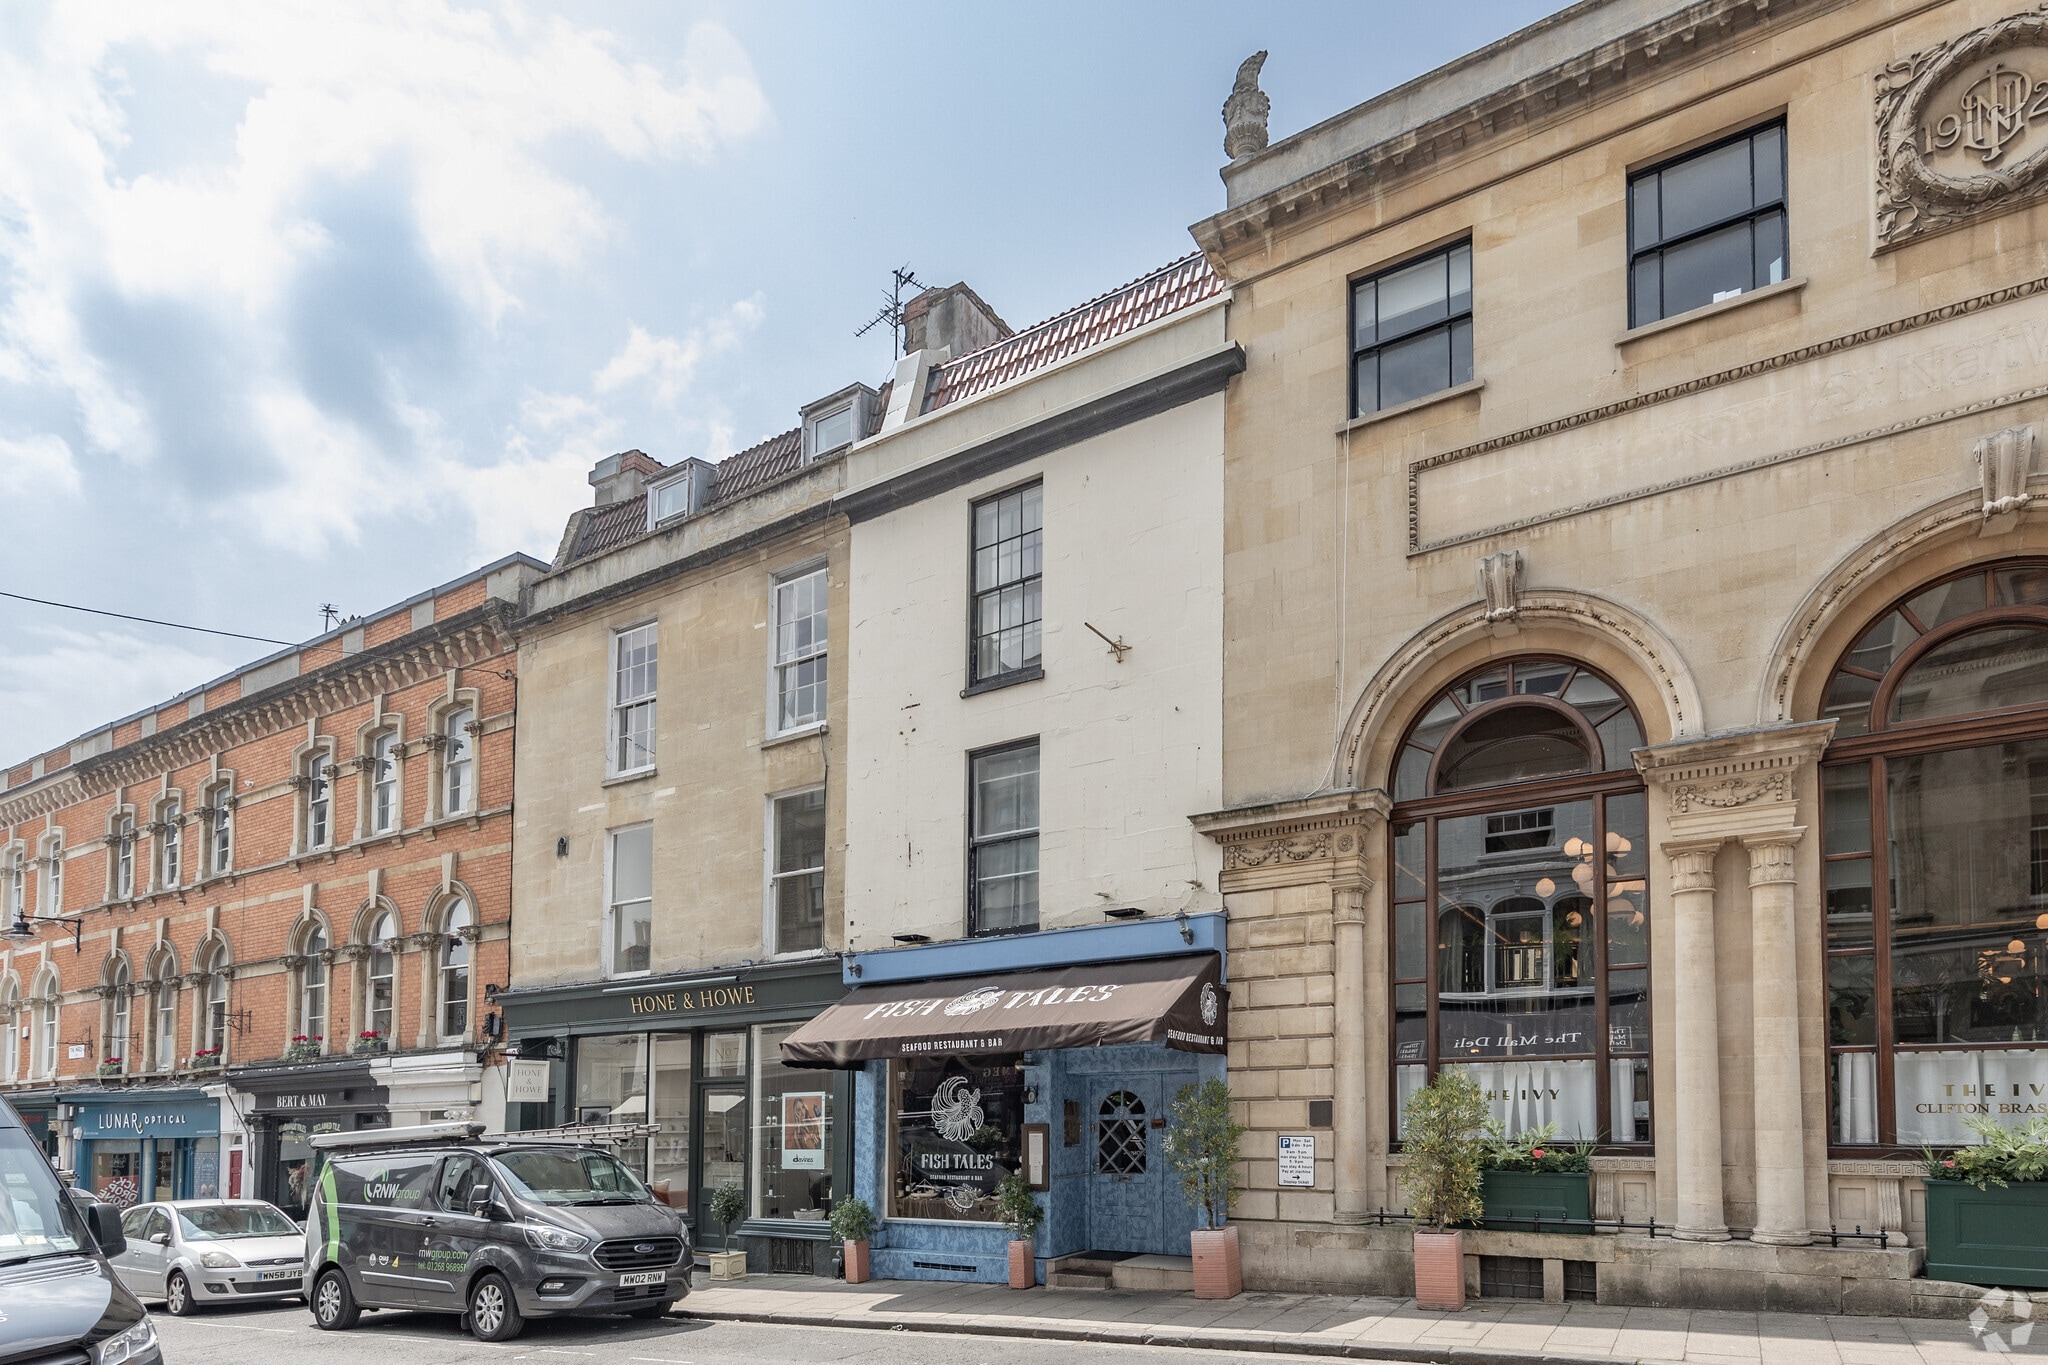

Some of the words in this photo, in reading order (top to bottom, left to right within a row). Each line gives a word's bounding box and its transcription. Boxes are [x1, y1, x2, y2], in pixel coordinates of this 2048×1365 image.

[630, 994, 677, 1014] HONE
[683, 992, 695, 1010] &
[700, 986, 755, 1008] HOWE
[863, 998, 945, 1020] FISH
[1003, 984, 1124, 1010] TALES
[1167, 1029, 1186, 1041] SEAFOOD
[901, 1041, 932, 1053] SEAFOOD
[933, 1039, 979, 1050] RESTAURANT
[980, 1039, 985, 1048] &
[987, 1037, 1003, 1047] BAR
[517, 1069, 542, 1077] HONE
[1521, 1089, 1560, 1100] IVY
[1943, 1084, 1996, 1097] THE
[276, 1095, 299, 1108] BERT
[300, 1094, 306, 1107] &
[308, 1093, 328, 1106] MAY
[1916, 1103, 1990, 1114] CLIFTON
[99, 1112, 143, 1135] LUNAR
[144, 1114, 186, 1124] OPTICAL
[1282, 1138, 1289, 1148] P
[921, 1153, 950, 1169] FISH
[952, 1153, 994, 1170] TALES
[418, 1249, 469, 1261] rnwgroup.com
[426, 1262, 445, 1272] 01268
[263, 1272, 285, 1280] WN58
[623, 1274, 646, 1285] MW02
[647, 1272, 663, 1283] RNW
